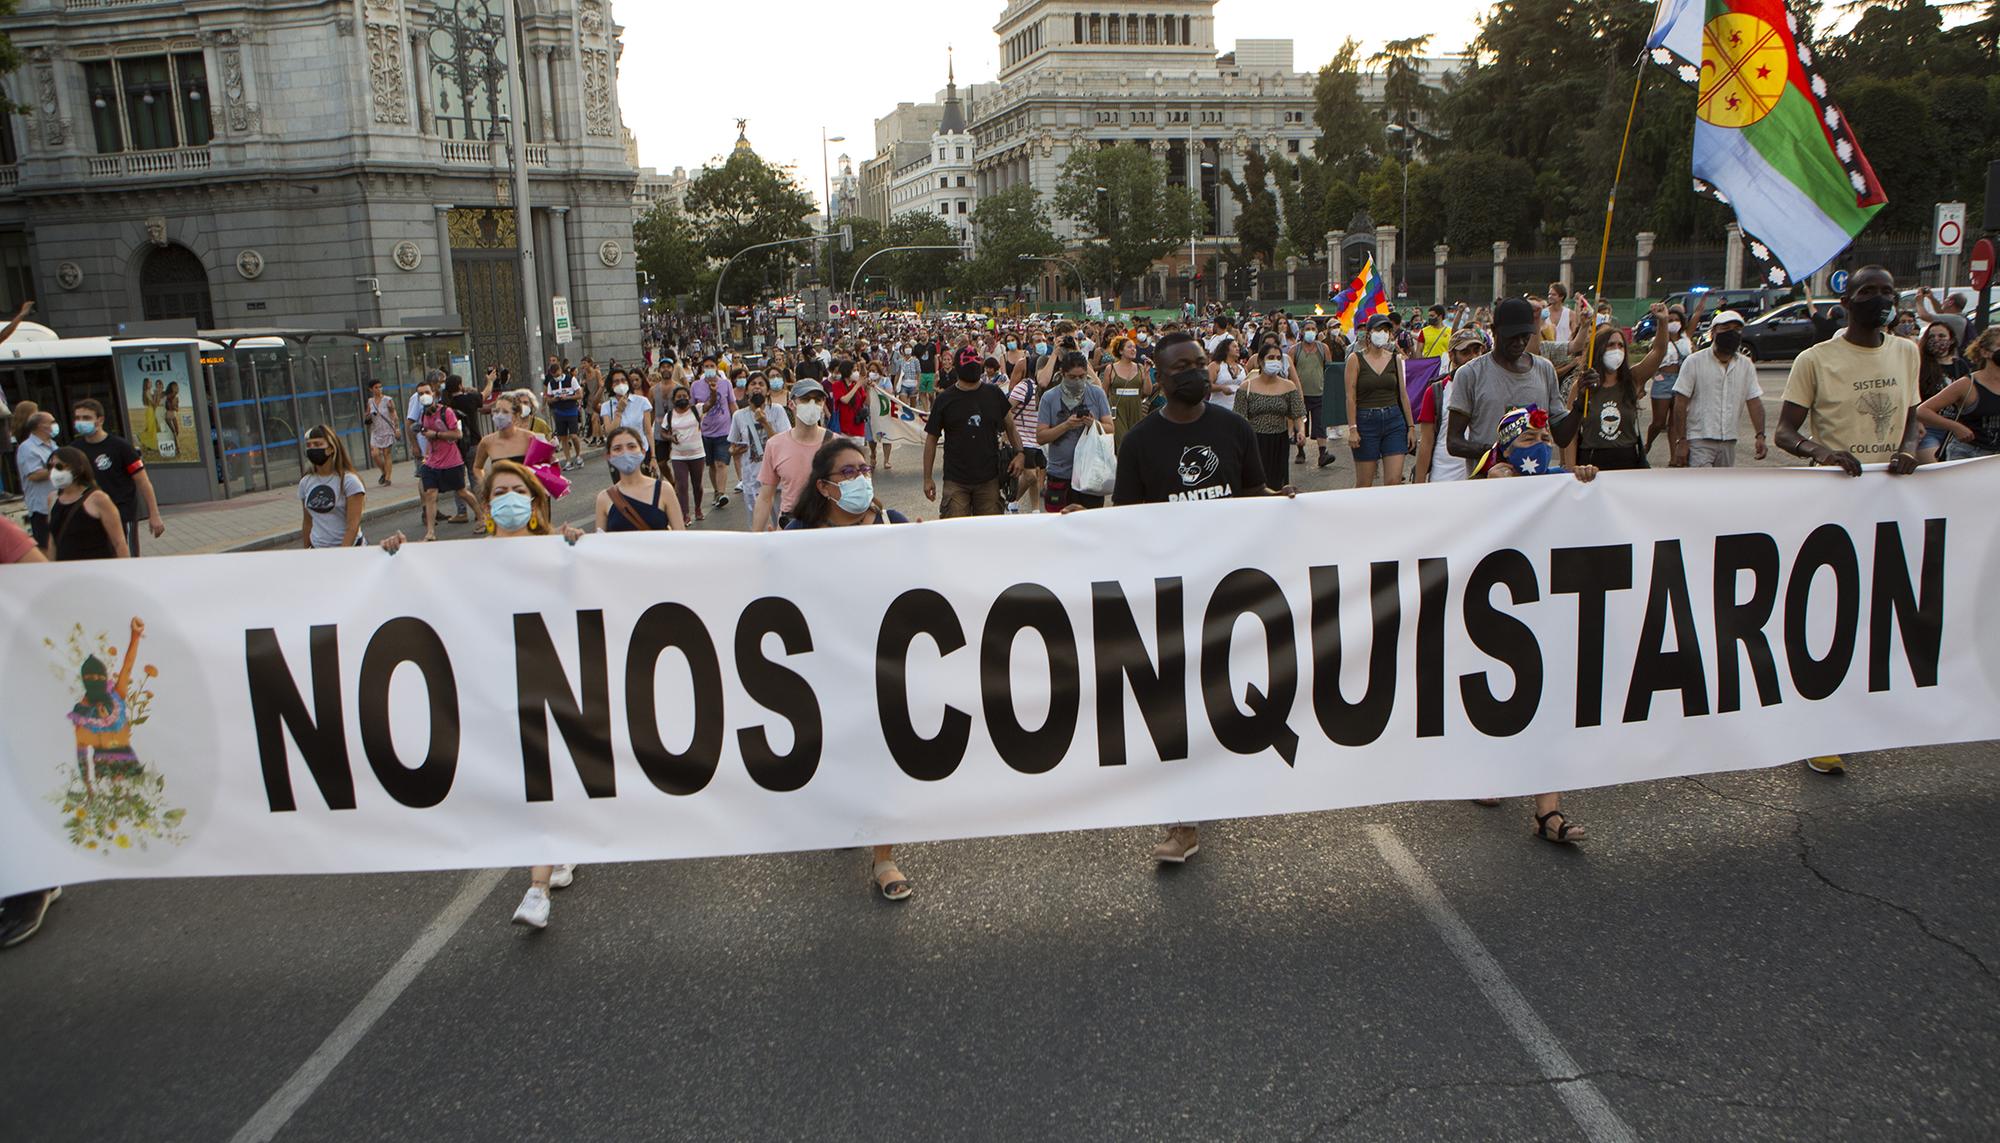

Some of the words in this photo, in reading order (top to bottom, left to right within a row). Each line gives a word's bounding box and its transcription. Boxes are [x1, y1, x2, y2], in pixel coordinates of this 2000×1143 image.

[137, 353, 172, 373] Girl
[1853, 378, 1897, 391] SISTEMA
[160, 442, 174, 452] Girl
[1168, 483, 1232, 502] PANTERA
[246, 617, 459, 812] NO
[513, 597, 822, 802] NOS
[876, 518, 1946, 781] CONQUISTARON
